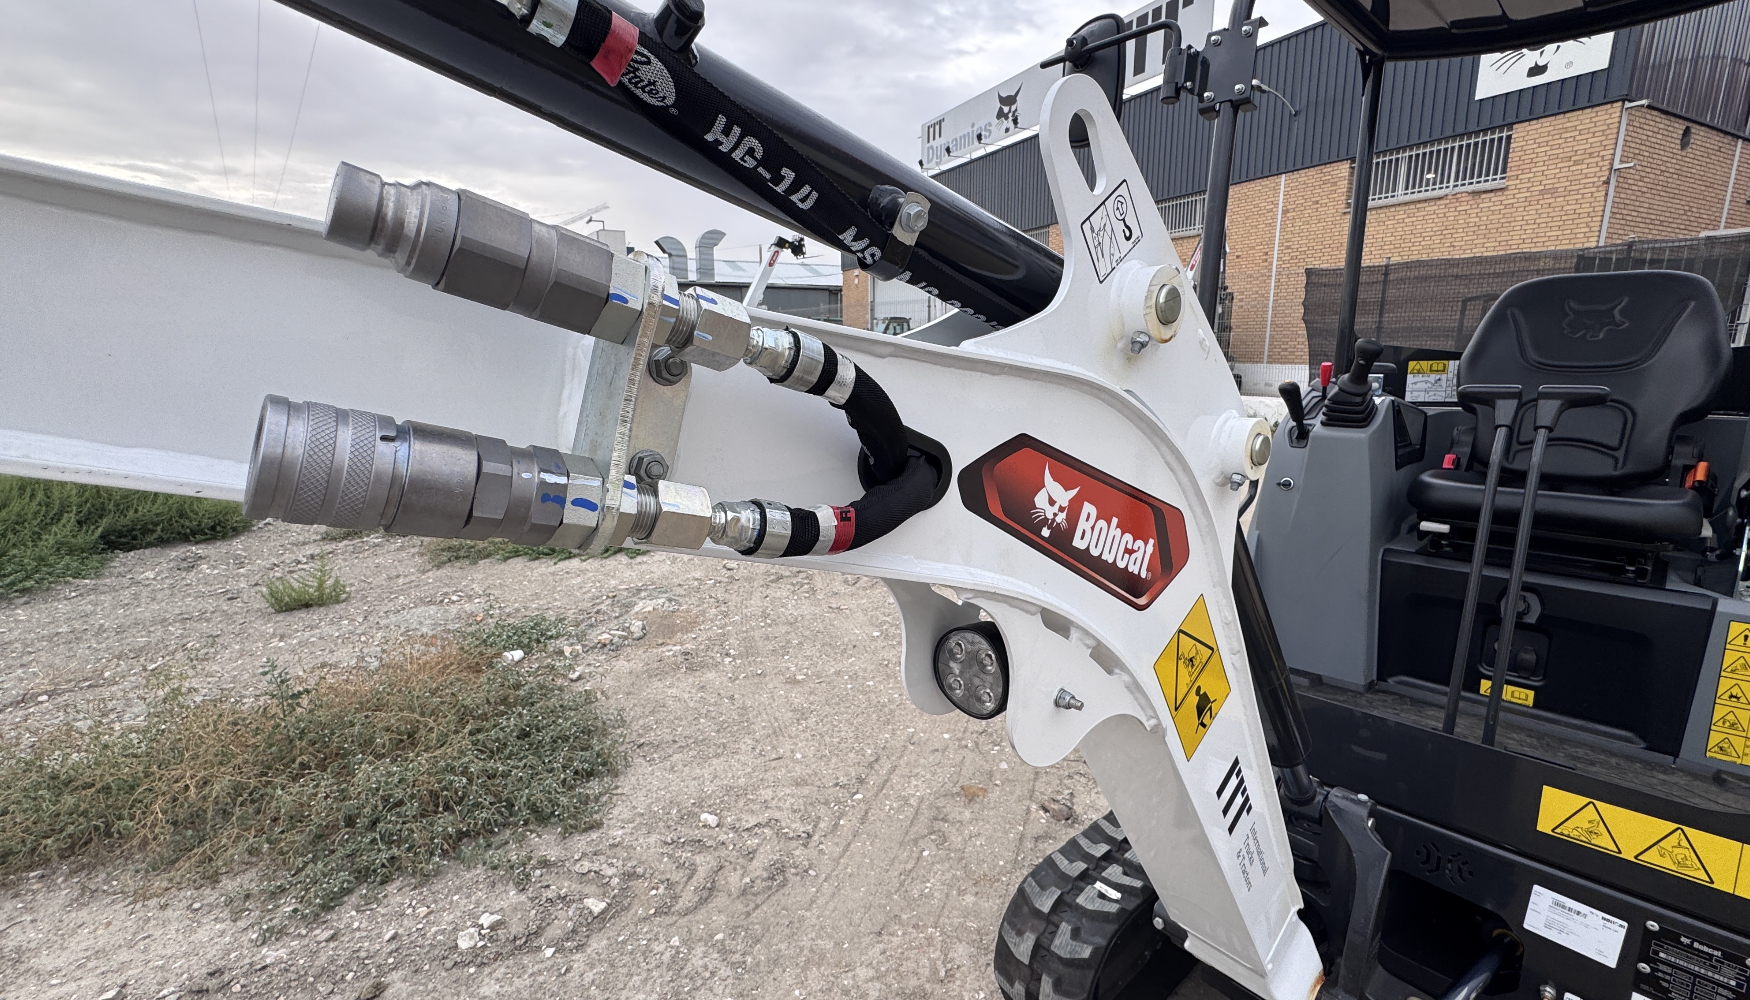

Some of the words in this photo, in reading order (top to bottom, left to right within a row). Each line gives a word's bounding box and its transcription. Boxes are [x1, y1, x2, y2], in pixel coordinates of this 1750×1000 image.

[926, 117, 945, 144] ITT
[1072, 501, 1155, 579] Bobcat
[1215, 755, 1253, 837] ITT
[1243, 833, 1255, 867] Trucks
[1249, 821, 1270, 877] International
[1239, 854, 1253, 893] Tractors
[1693, 941, 1722, 957] Bobcat
